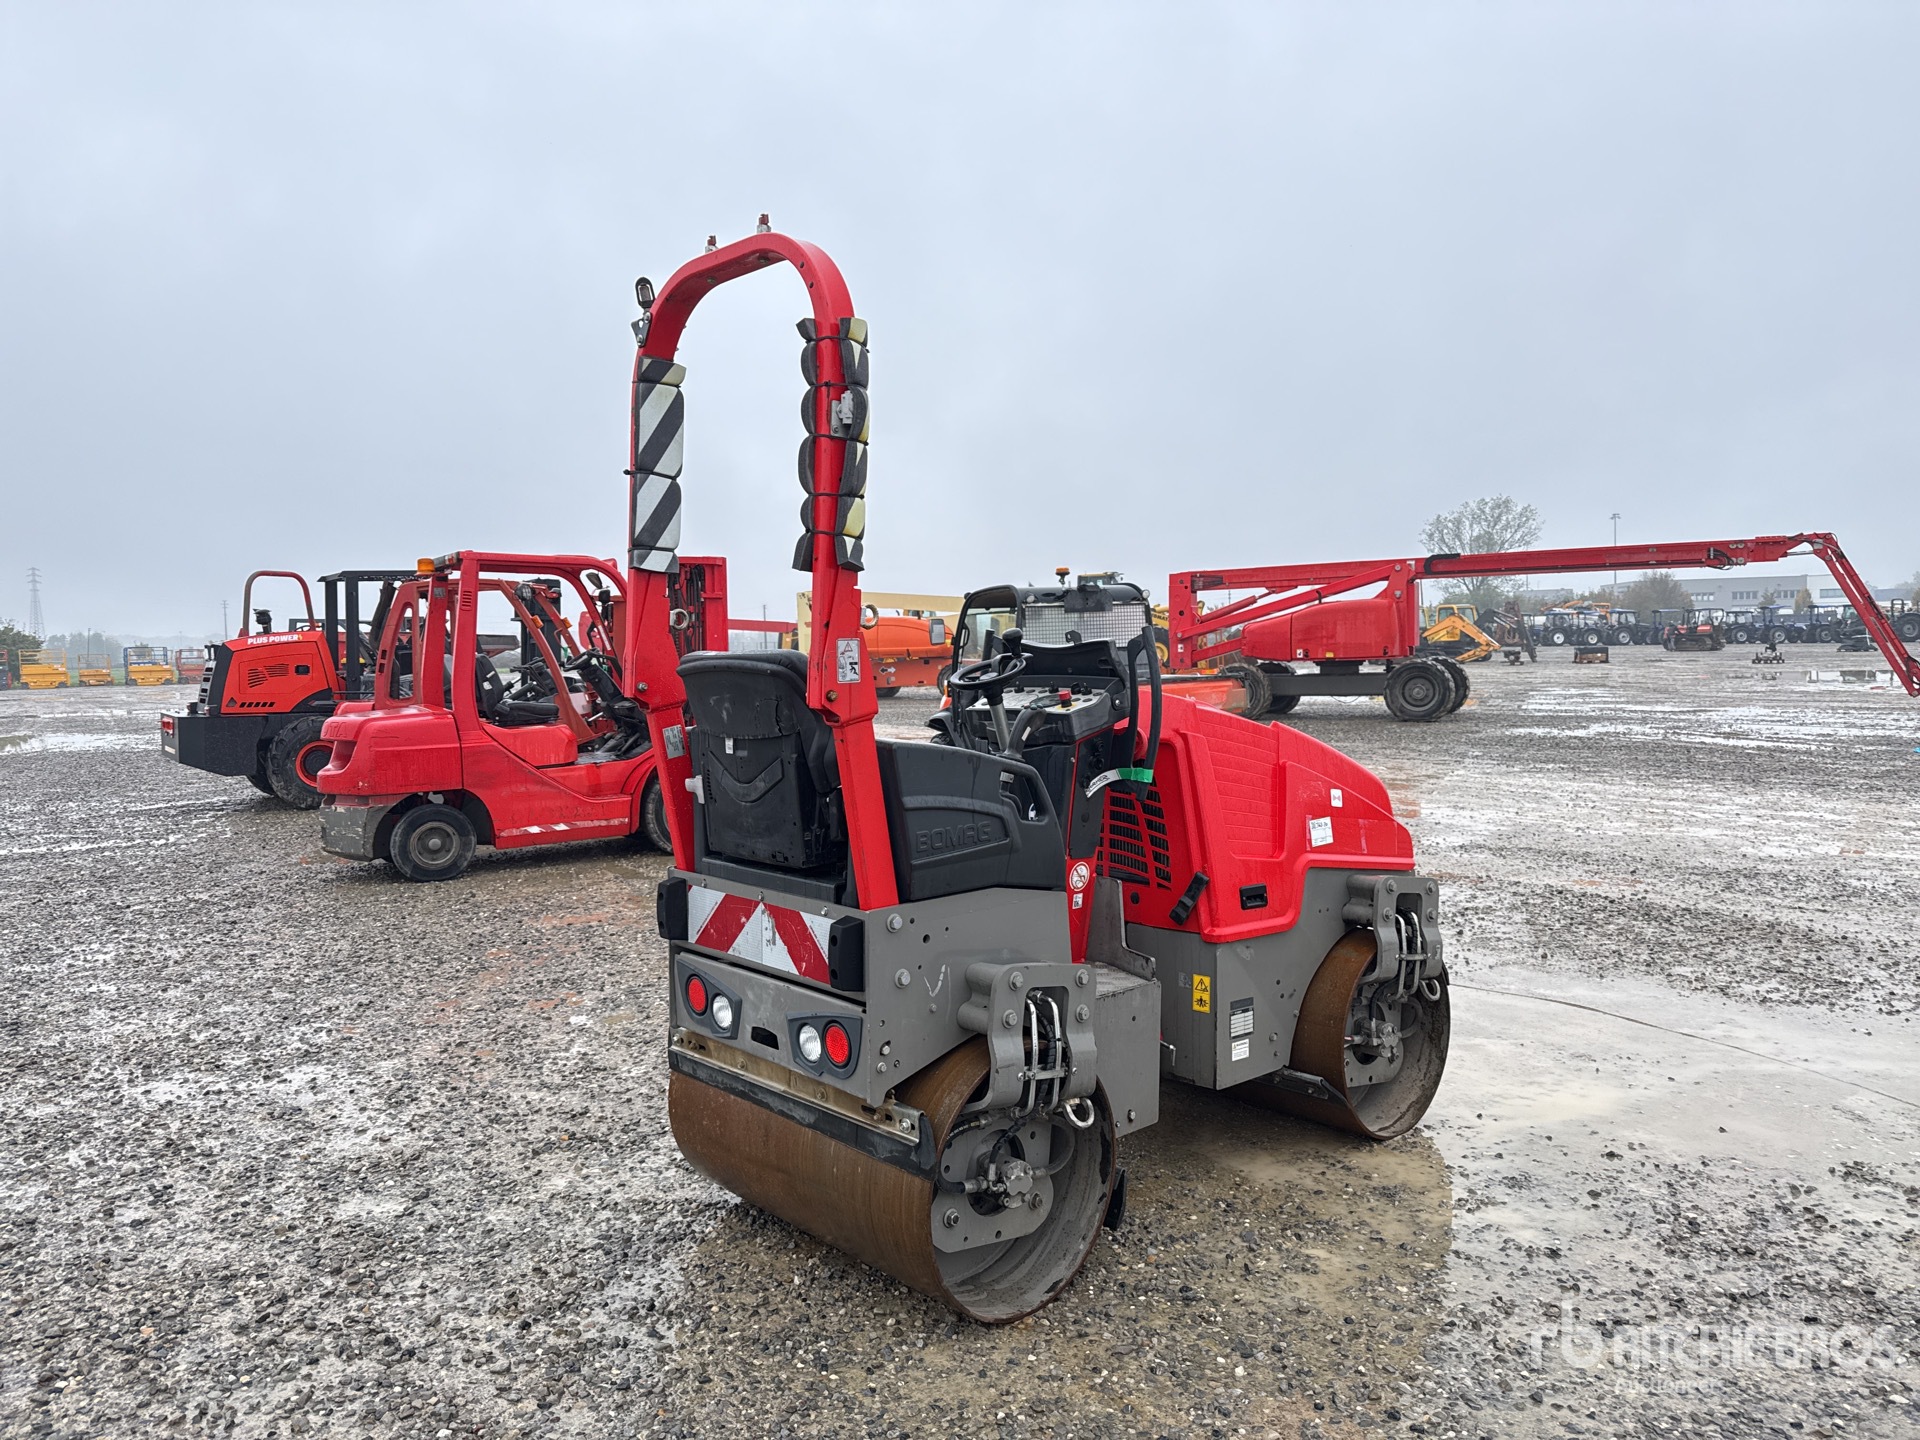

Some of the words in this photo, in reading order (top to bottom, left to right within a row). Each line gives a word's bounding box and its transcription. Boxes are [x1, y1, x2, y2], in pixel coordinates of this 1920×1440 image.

[247, 636, 269, 645] PLUS
[269, 634, 298, 643] POWER
[915, 820, 992, 853] BOMAG
